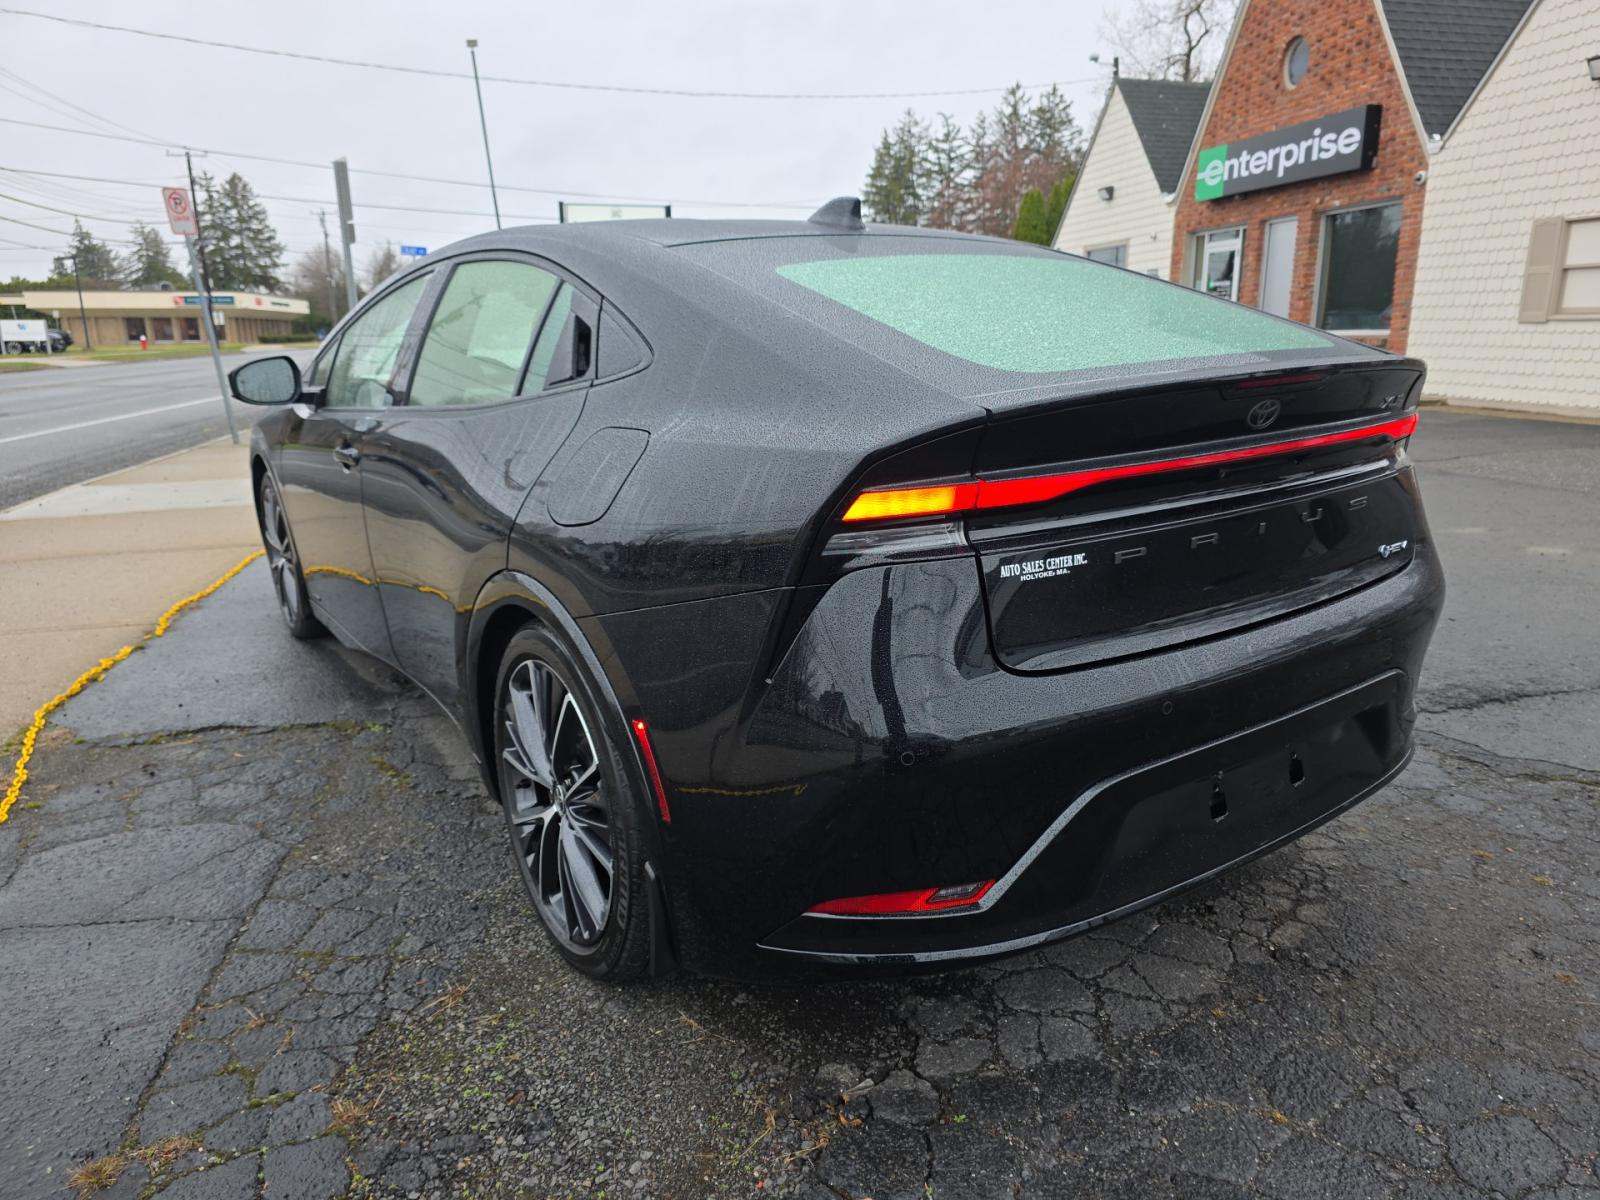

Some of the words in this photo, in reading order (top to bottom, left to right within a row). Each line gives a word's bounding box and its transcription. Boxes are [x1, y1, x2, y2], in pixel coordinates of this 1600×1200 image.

[1197, 126, 1362, 186] enterprise
[1000, 563, 1021, 578] AUTO
[1022, 559, 1045, 574] SALES
[1046, 555, 1073, 570] CENTER
[1073, 552, 1088, 566] INC.
